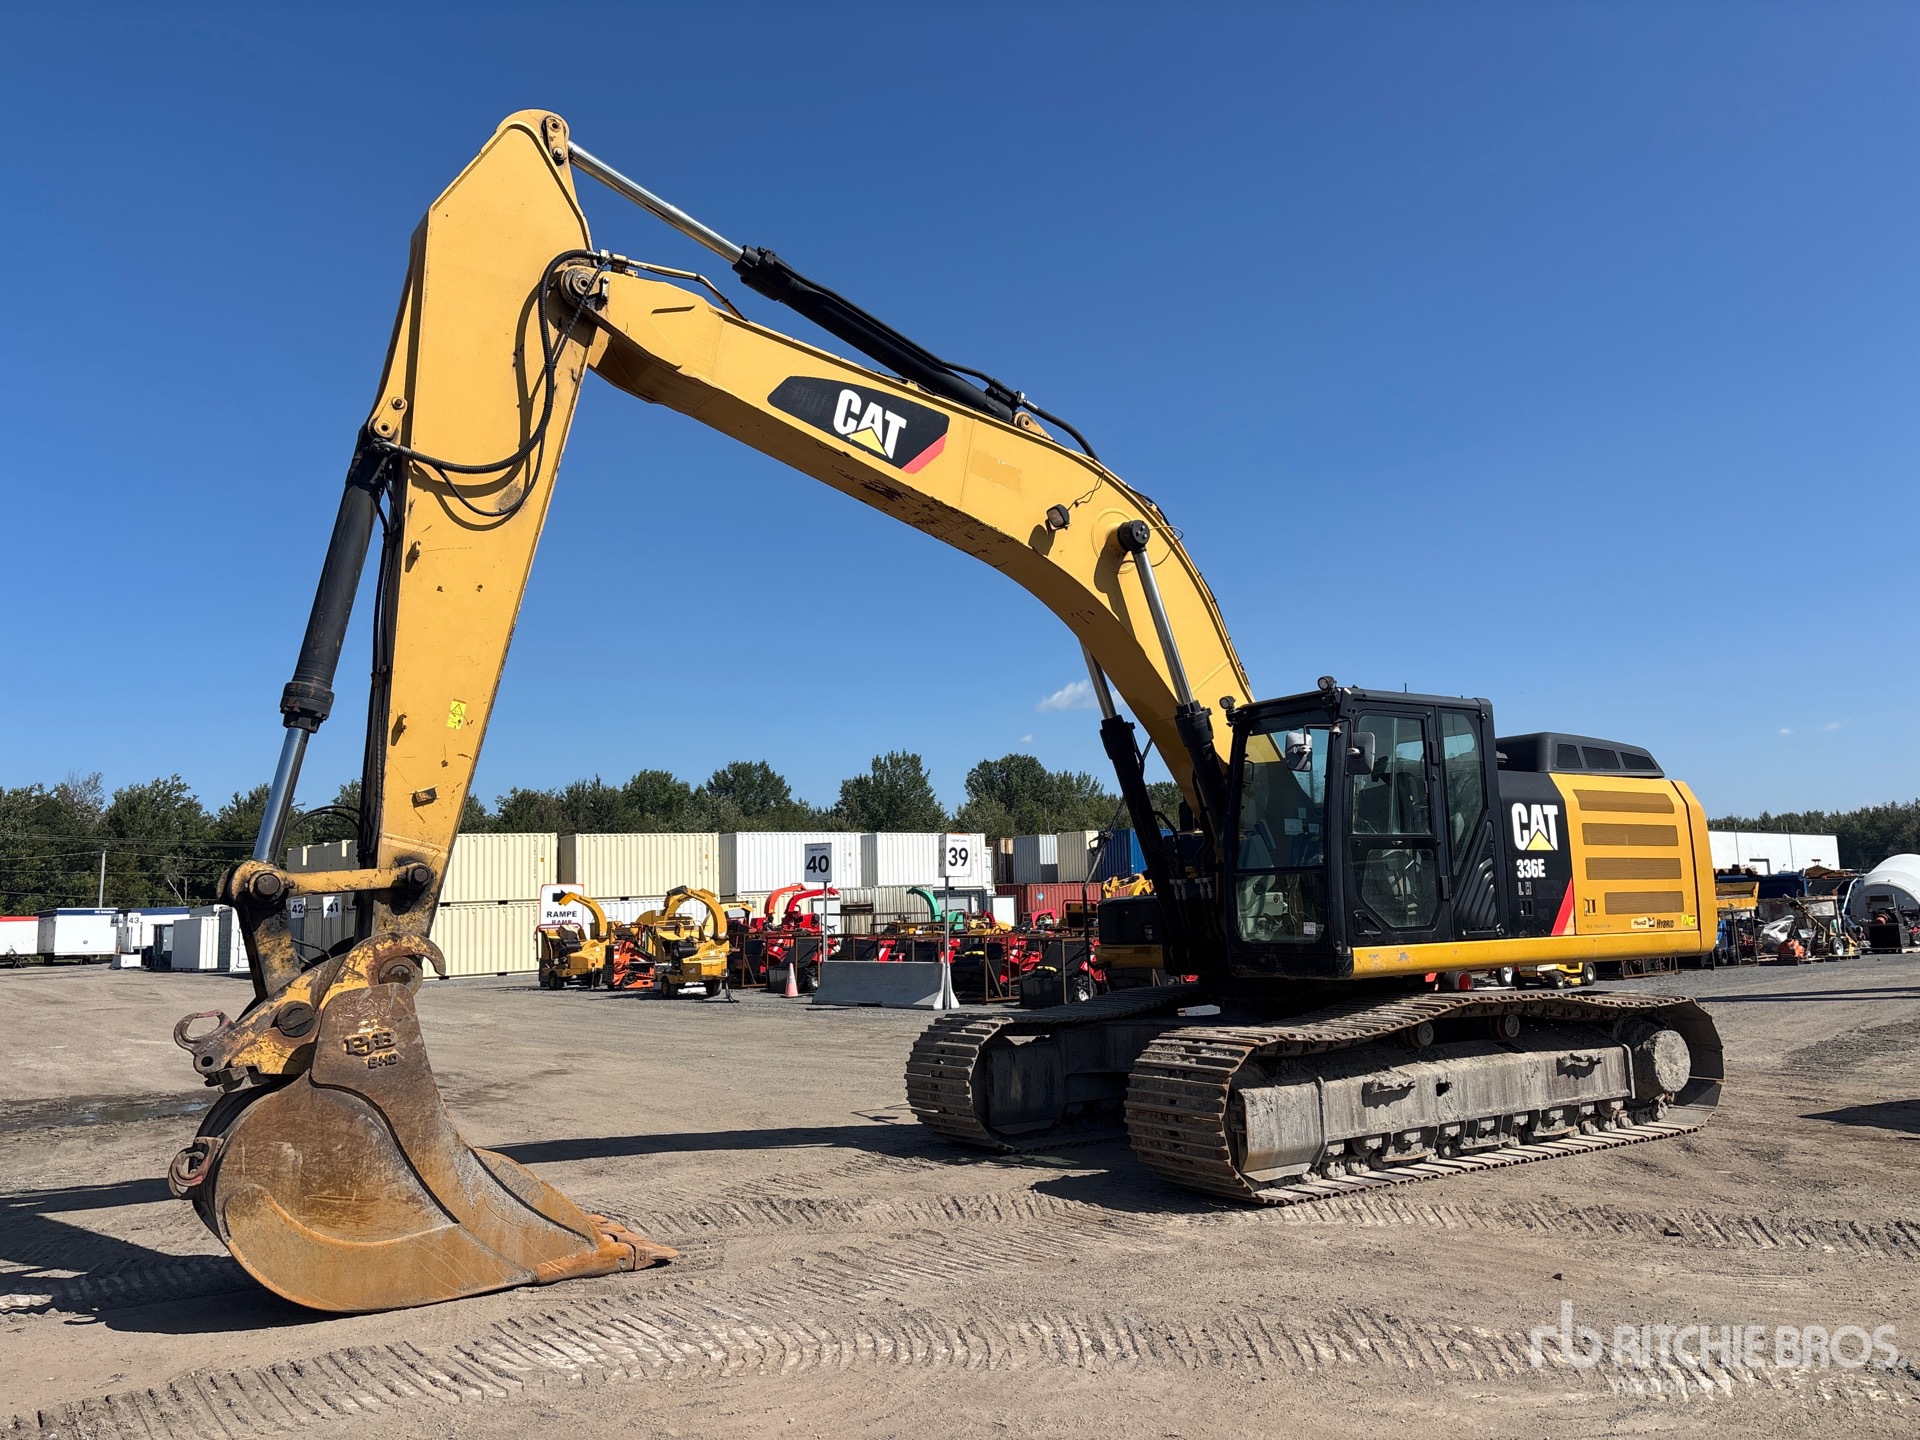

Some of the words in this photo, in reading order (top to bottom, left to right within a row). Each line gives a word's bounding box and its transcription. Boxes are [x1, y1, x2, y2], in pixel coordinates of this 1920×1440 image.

[833, 389, 907, 459] CAT
[1511, 802, 1559, 851] CAT
[806, 855, 830, 873] 40
[948, 847, 969, 867] 39
[1516, 858, 1546, 878] 336E
[291, 903, 304, 914] 42
[326, 902, 339, 913] 41
[546, 910, 577, 918] RAMPE
[128, 916, 140, 924] 43
[1656, 918, 1675, 929] HYBRID
